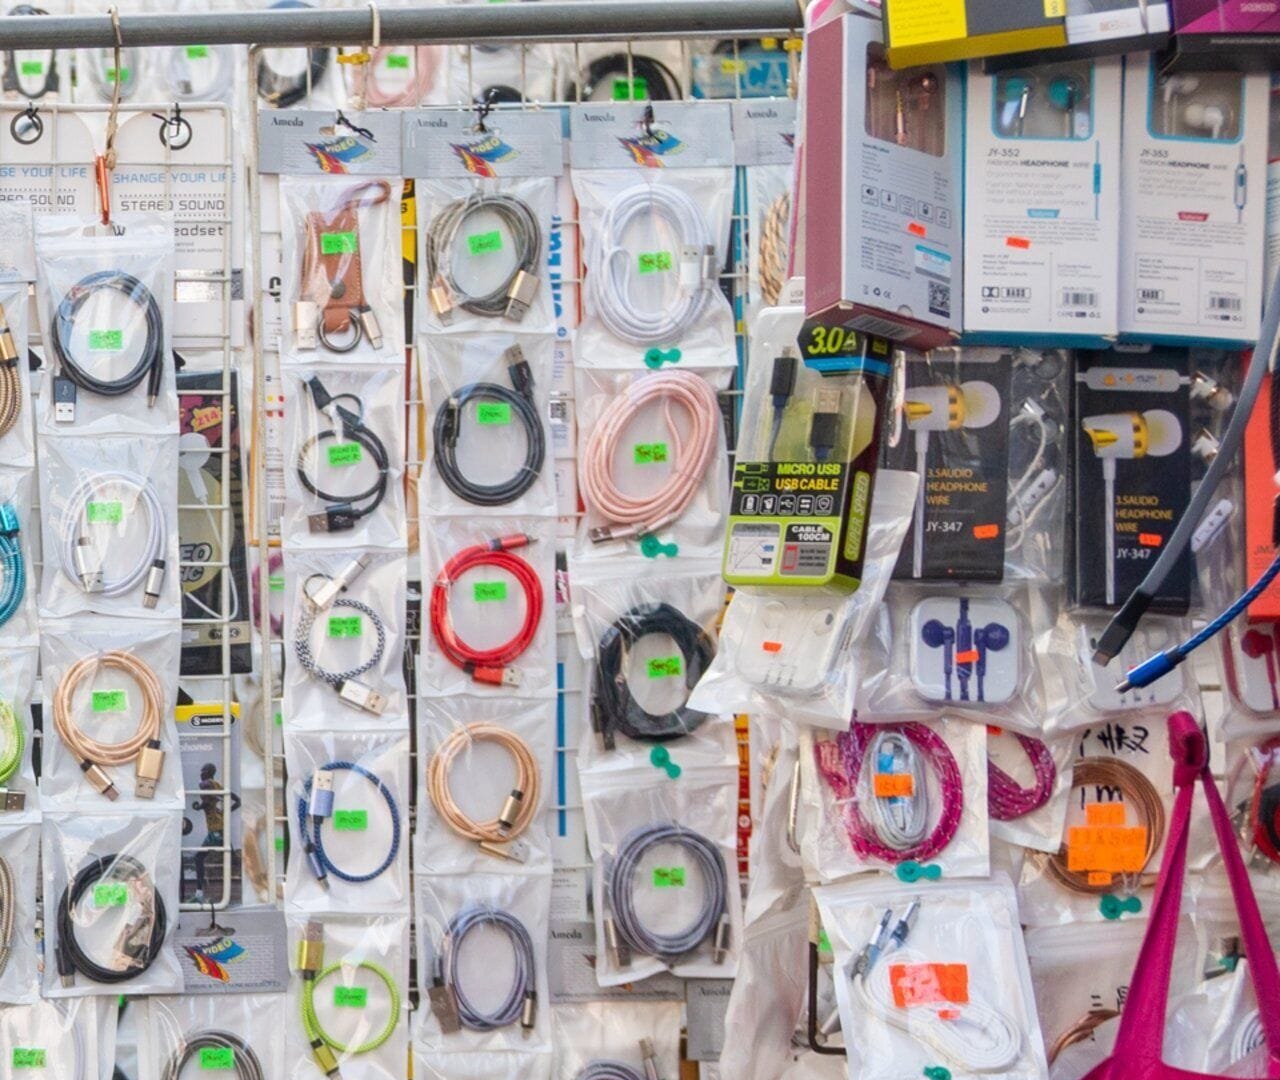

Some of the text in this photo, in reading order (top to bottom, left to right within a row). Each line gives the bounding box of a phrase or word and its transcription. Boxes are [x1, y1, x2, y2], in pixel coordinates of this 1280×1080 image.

[270, 116, 305, 127] Ameda
[987, 148, 1020, 158] JY-352
[1020, 160, 1070, 169] HEADPHONE
[1168, 161, 1210, 170] HEADPHONE
[61, 167, 87, 178] LIFE
[170, 172, 207, 183] YOUR
[179, 200, 225, 211] SOUND
[174, 225, 224, 237] eadset
[777, 463, 842, 476] MICRO USB
[801, 478, 839, 491] CABLE
[927, 482, 988, 492] HEADPHONE
[926, 494, 950, 505] WIRE
[1116, 509, 1173, 520] HEADPHONE
[791, 524, 824, 534] CABLE
[925, 521, 963, 532] JY-347
[1116, 522, 1139, 532] WIRE
[797, 532, 830, 542] 100CM
[1116, 548, 1152, 560] JY-347
